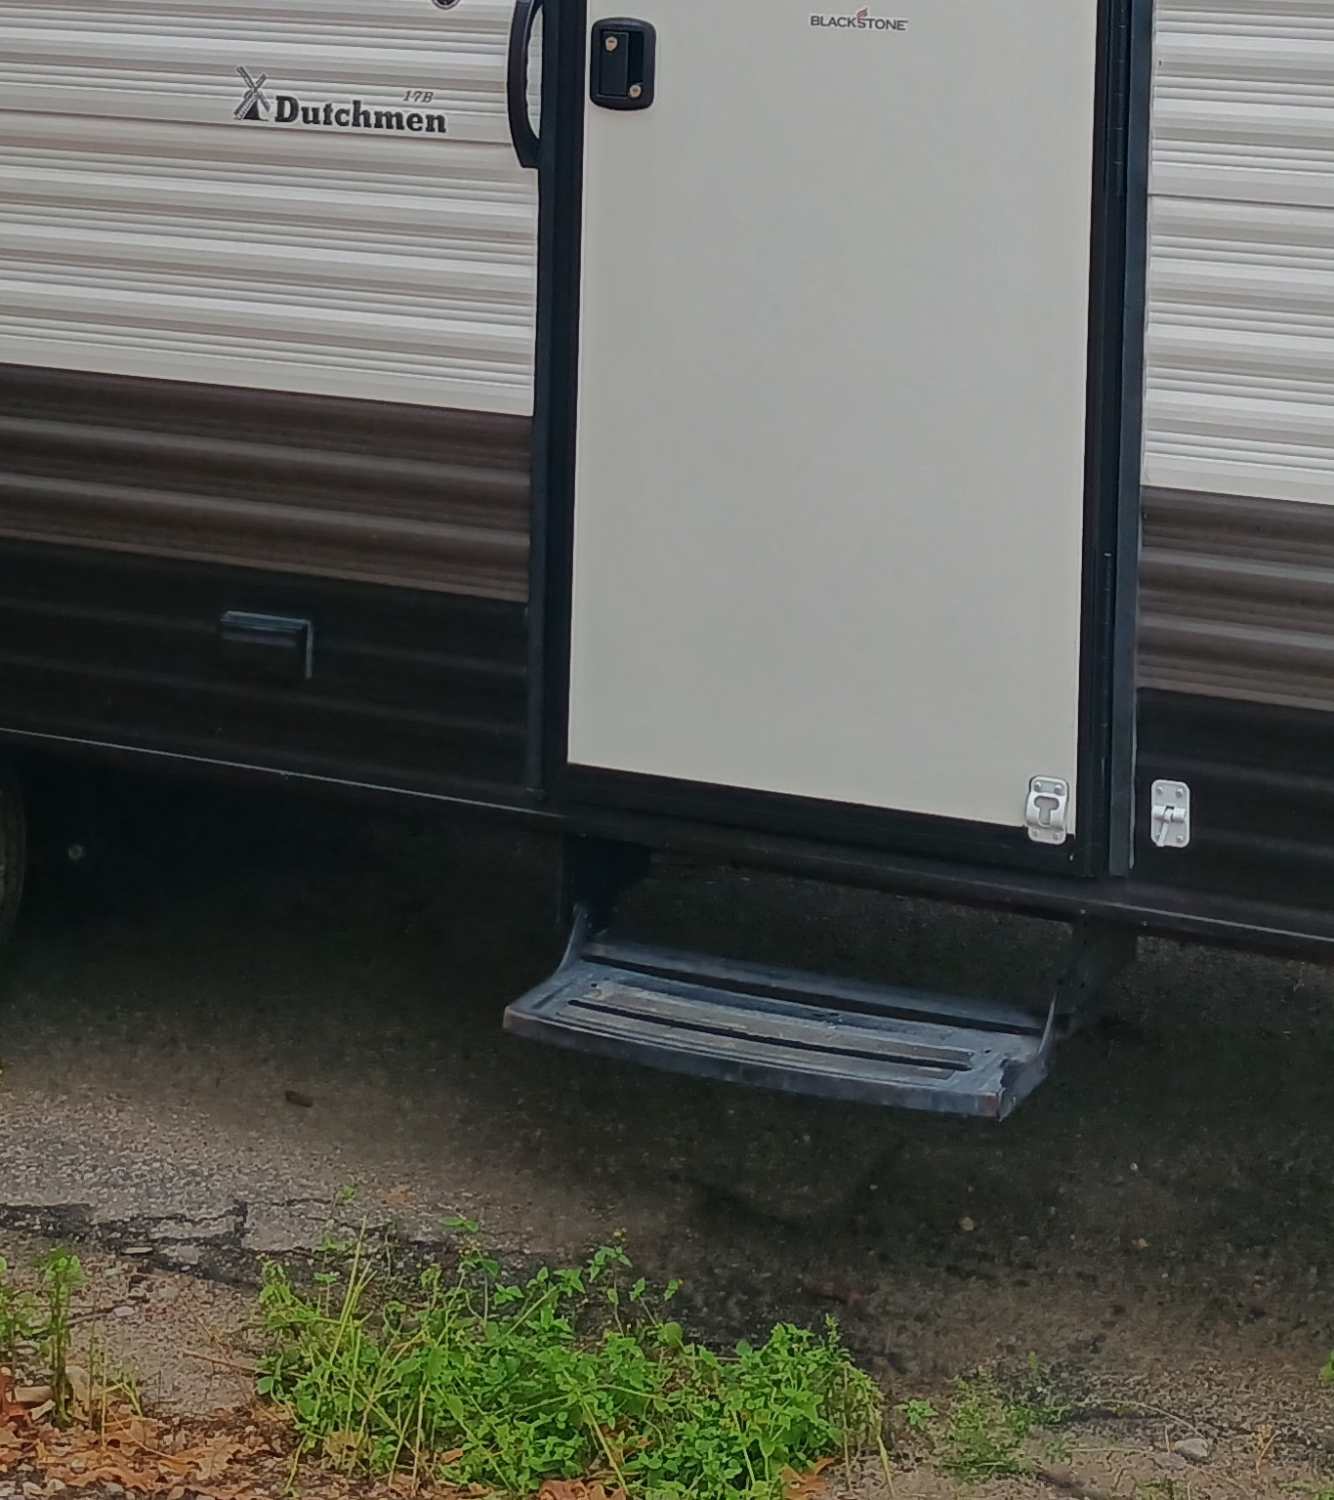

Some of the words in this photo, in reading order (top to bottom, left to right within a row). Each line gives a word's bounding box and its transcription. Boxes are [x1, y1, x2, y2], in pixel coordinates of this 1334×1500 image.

[810, 14, 908, 31] BLACKSTONE
[402, 90, 434, 104] 17B
[274, 95, 447, 133] Dutchmen
